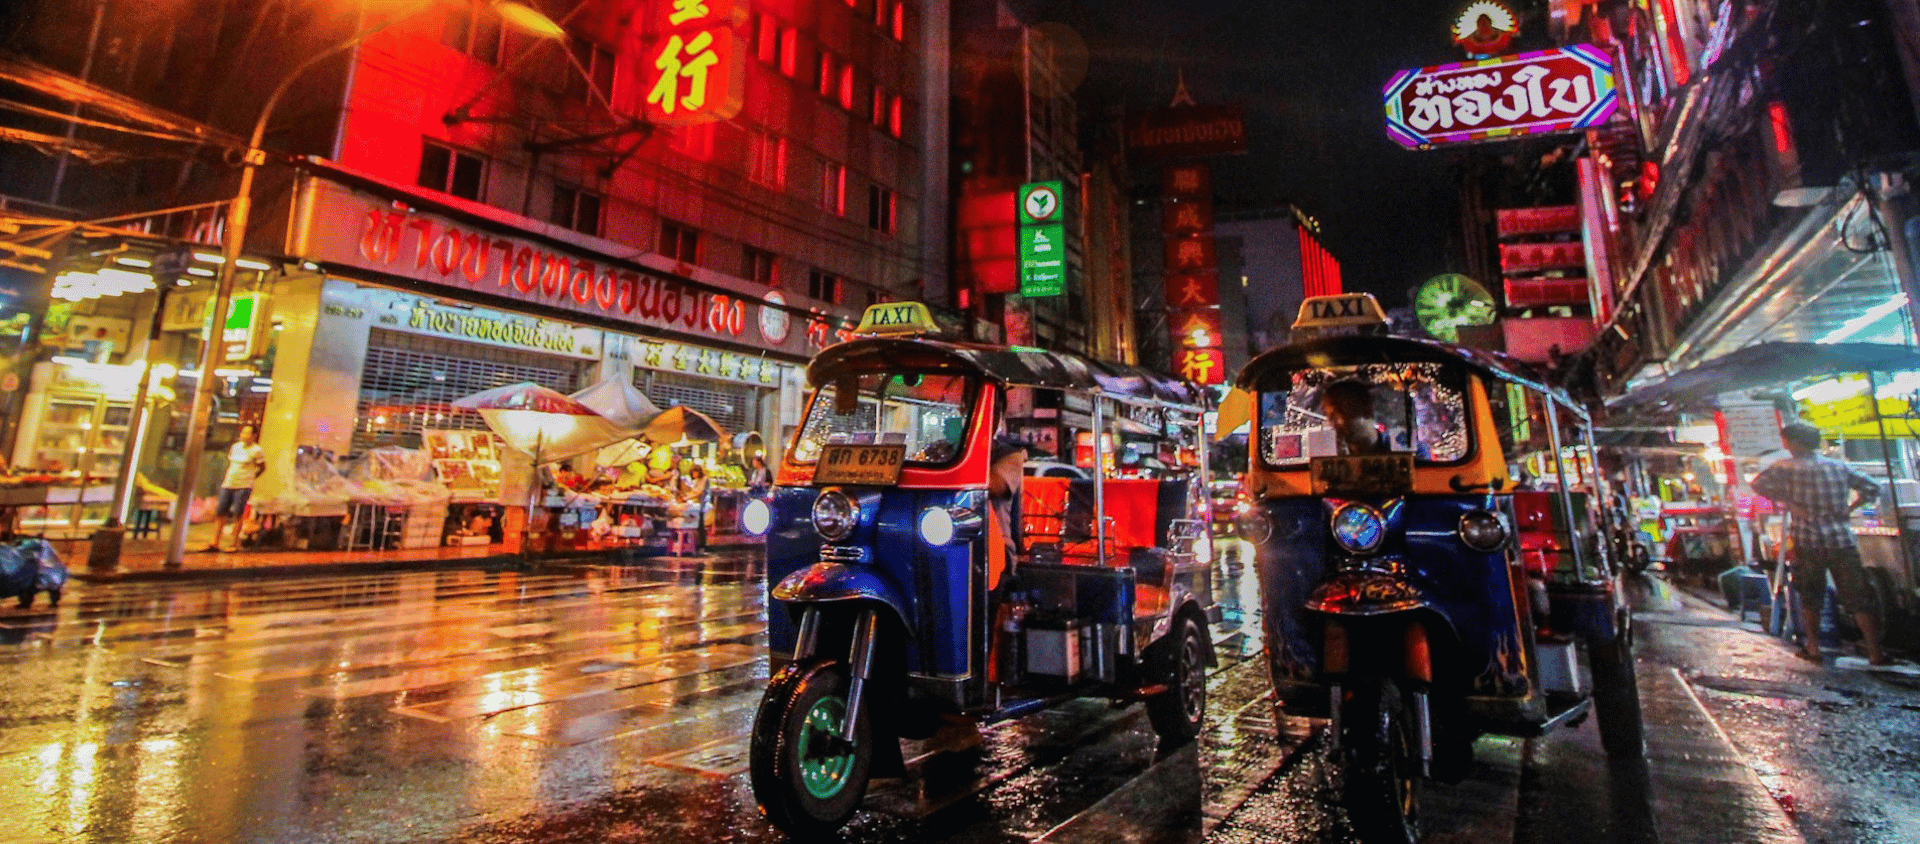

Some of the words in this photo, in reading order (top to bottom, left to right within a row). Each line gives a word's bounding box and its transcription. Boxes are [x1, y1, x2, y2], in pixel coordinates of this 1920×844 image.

[1408, 64, 1591, 131] ทองใบ
[871, 305, 914, 325] TAXI
[1308, 297, 1365, 318] TAXI
[858, 449, 898, 466] 6738
